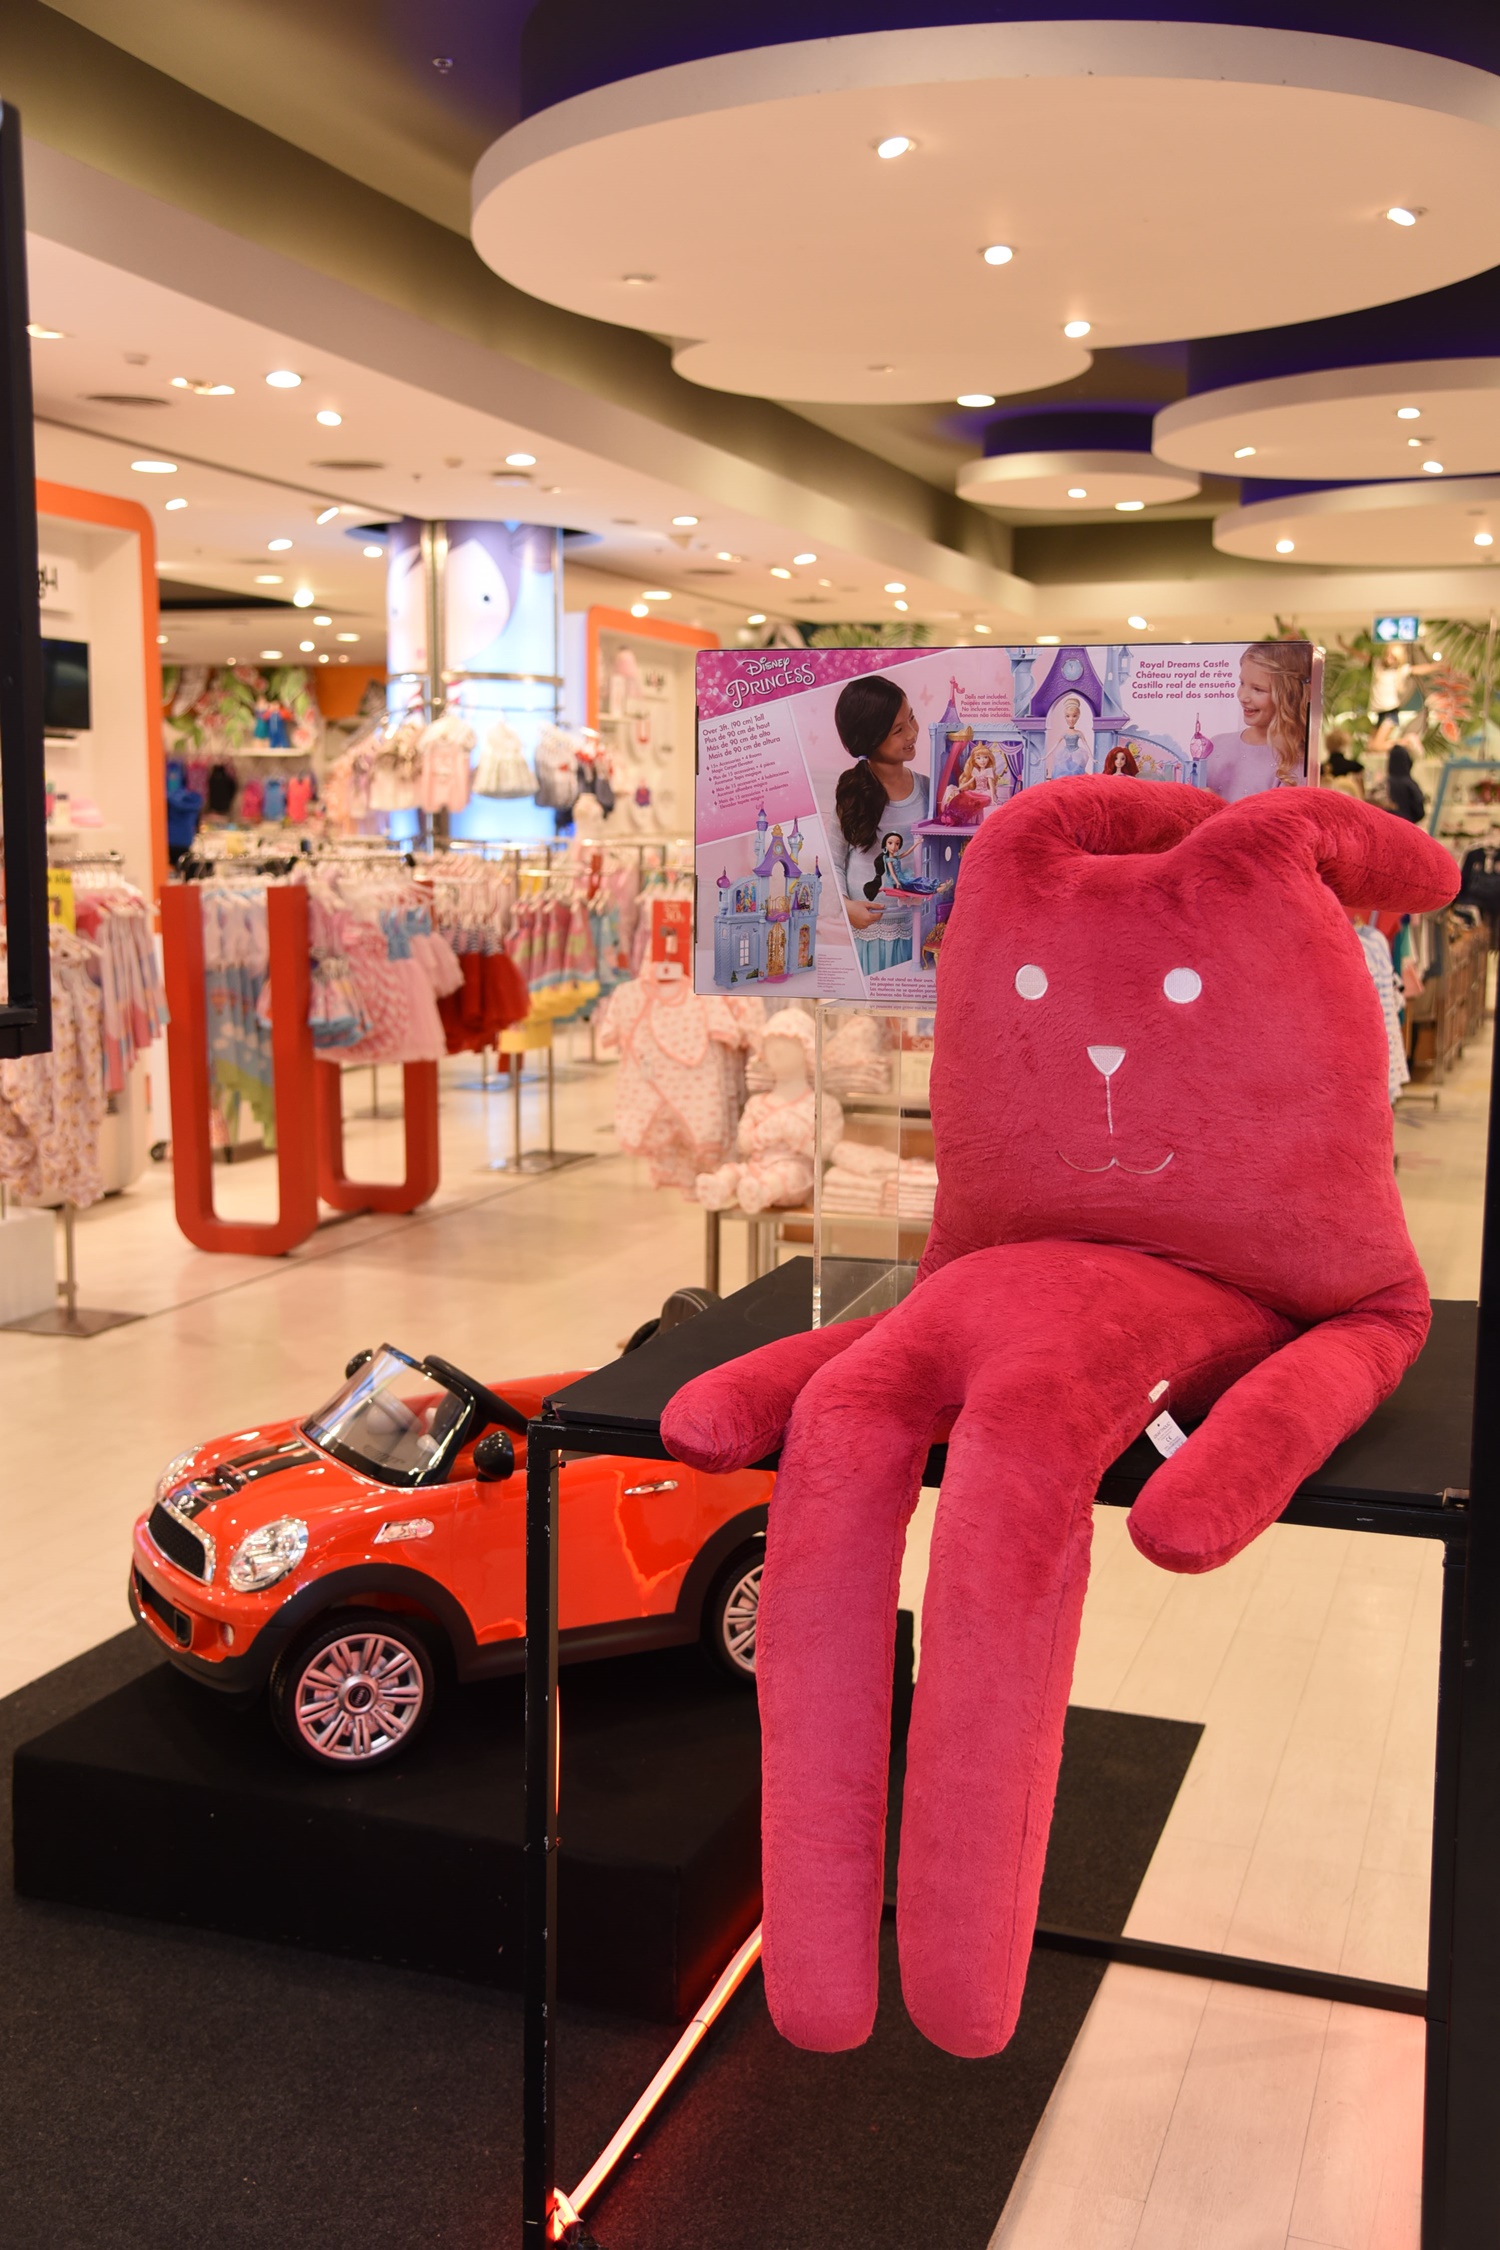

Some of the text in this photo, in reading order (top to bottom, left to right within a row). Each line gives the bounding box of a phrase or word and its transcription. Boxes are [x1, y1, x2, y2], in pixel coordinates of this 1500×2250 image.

[1140, 661, 1164, 670] Royal
[1203, 660, 1229, 668] Castle
[1174, 671, 1197, 680] royal
[1213, 670, 1232, 678] rêve
[1132, 681, 1163, 689] Castillo
[1132, 691, 1163, 699] Castelo
[703, 728, 717, 736] Over
[731, 721, 740, 729] (90
[743, 717, 753, 726] cm)
[754, 713, 764, 721] Tall
[757, 722, 770, 730] haut
[730, 738, 738, 746] 90
[759, 730, 771, 738] alto
[709, 752, 723, 760] Mais
[763, 737, 780, 746] altura
